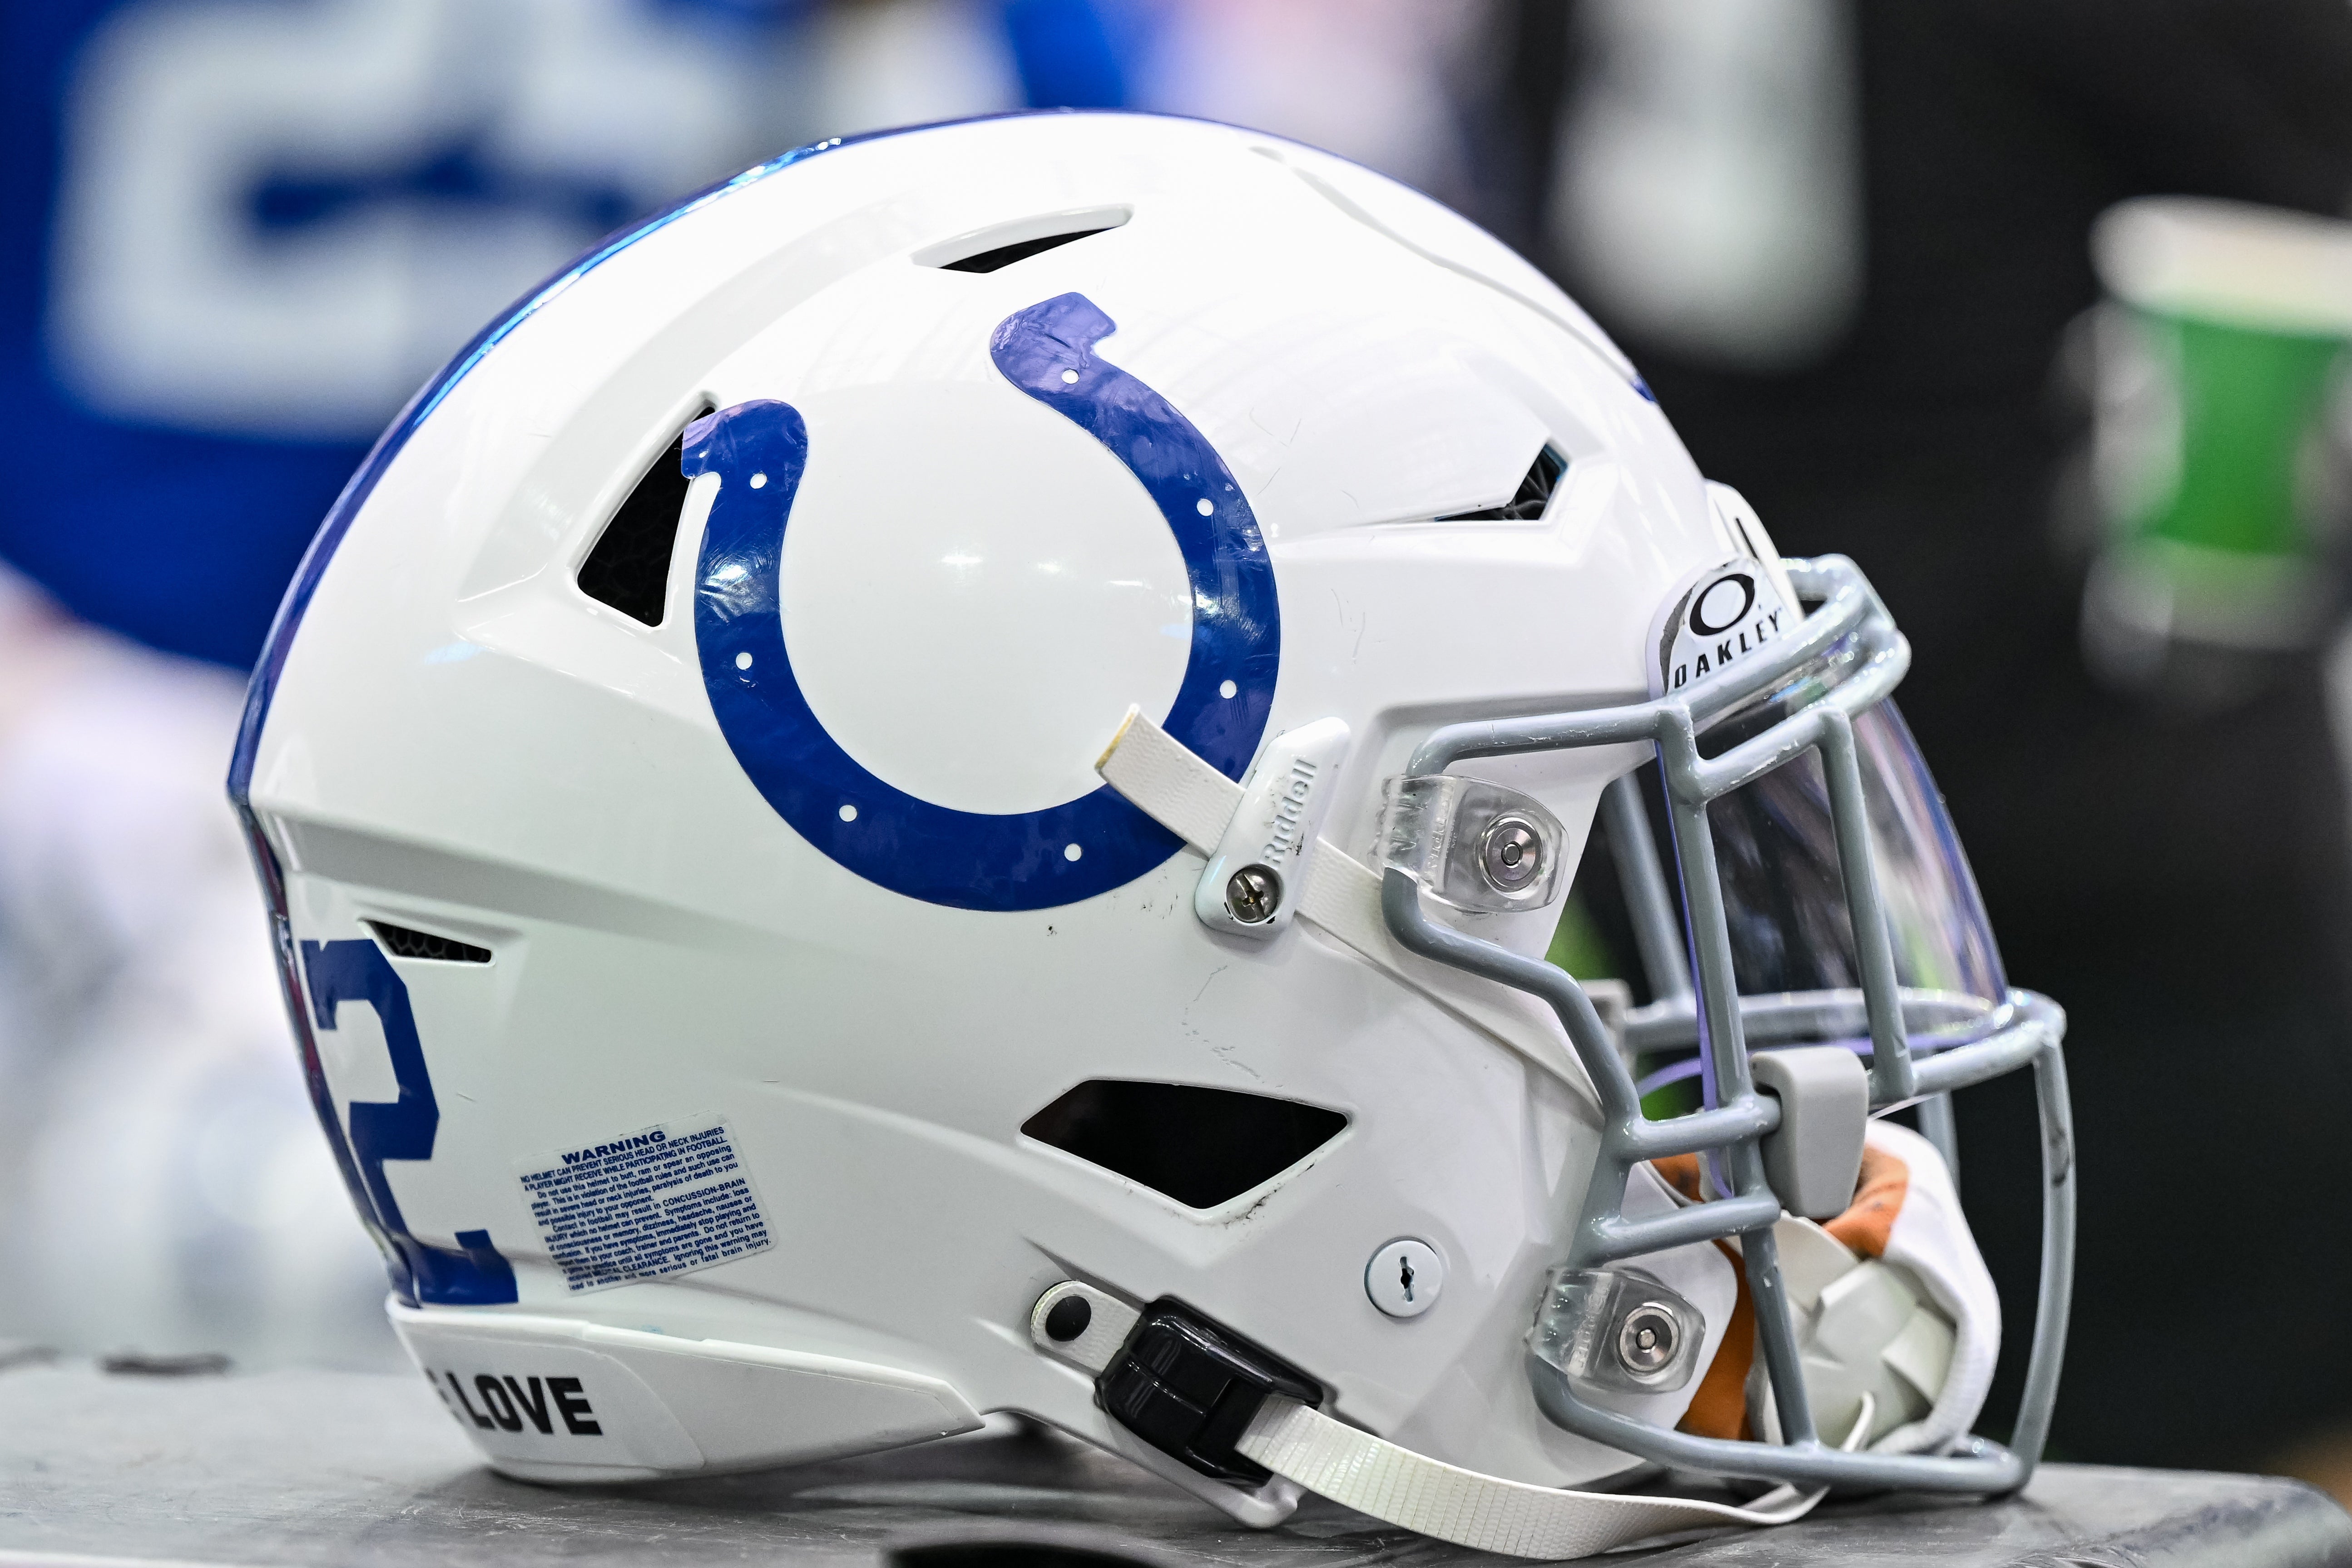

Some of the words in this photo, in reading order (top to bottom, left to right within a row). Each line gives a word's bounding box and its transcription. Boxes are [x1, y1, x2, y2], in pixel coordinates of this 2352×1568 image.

[1674, 609, 1779, 689] OAKLEY
[1260, 758, 1317, 866] Riddell
[300, 939, 519, 1305] 2
[530, 1170, 555, 1181] HELMET
[556, 1167, 571, 1176] CAN
[571, 1159, 601, 1172] PREVENT
[603, 1152, 634, 1165] SERIOUS
[634, 1146, 654, 1157] HEAD
[655, 1143, 667, 1151] OR
[668, 1137, 689, 1148] NECK
[689, 1127, 724, 1142] INJURIES
[562, 1131, 665, 1164] WARNING
[572, 1182, 586, 1191] this
[586, 1177, 610, 1187] helmet
[619, 1171, 636, 1180] butt,
[638, 1167, 651, 1176] ram
[663, 1158, 682, 1169] spear
[696, 1145, 732, 1160] opposing
[574, 1168, 603, 1181] RECEIVE
[602, 1163, 625, 1174] WHILE
[625, 1150, 677, 1168] PARTICIPATING
[677, 1147, 685, 1155] IN
[580, 1188, 608, 1198] violation
[609, 1184, 616, 1192] of
[628, 1175, 654, 1187] football
[654, 1171, 672, 1180] rules
[673, 1166, 687, 1176] and
[688, 1161, 705, 1171] such
[706, 1158, 720, 1166] use
[721, 1153, 734, 1162] can
[580, 1198, 597, 1208] head
[606, 1192, 623, 1202] neck
[623, 1187, 651, 1198] injuries,
[652, 1177, 683, 1192] paralysis
[684, 1173, 692, 1182] of
[693, 1168, 713, 1179] death
[723, 1162, 738, 1172] you
[576, 1210, 595, 1218] injury
[603, 1204, 619, 1213] your
[587, 1213, 613, 1225] football
[614, 1211, 629, 1219] may
[631, 1204, 652, 1215] result
[663, 1178, 745, 1206] CONCUSSION-BRAIN
[597, 1222, 620, 1232] helmet
[664, 1202, 702, 1216] Symptoms
[702, 1192, 732, 1205] include:
[732, 1187, 749, 1197] loss
[642, 1218, 677, 1231] dizziness,
[677, 1208, 714, 1222] headache,
[716, 1199, 743, 1211] nausea
[589, 1252, 598, 1261] to
[598, 1252, 613, 1260] your
[614, 1246, 635, 1256] coach,
[635, 1242, 657, 1251] trainer
[659, 1237, 672, 1246] and
[672, 1231, 701, 1243] parents.
[715, 1221, 728, 1230] not
[728, 1215, 751, 1226] return
[618, 1255, 633, 1264] until
[644, 1245, 679, 1259] symptoms
[694, 1236, 713, 1247] gone
[714, 1230, 728, 1240] and
[729, 1227, 743, 1237] you
[744, 1221, 763, 1231] have
[619, 1233, 656, 1246] symptoms,
[655, 1221, 696, 1237] immediately
[698, 1217, 714, 1226] stop
[714, 1209, 742, 1222] playing
[742, 1203, 756, 1213] and
[673, 1248, 703, 1261] Ignoring
[704, 1243, 719, 1252] this
[720, 1235, 750, 1247] warning
[751, 1229, 767, 1238] may
[659, 1262, 687, 1273] serious
[701, 1252, 719, 1262] fatal
[721, 1246, 743, 1256] brain
[745, 1238, 771, 1249] injury.
[445, 1370, 603, 1436] LOVE
